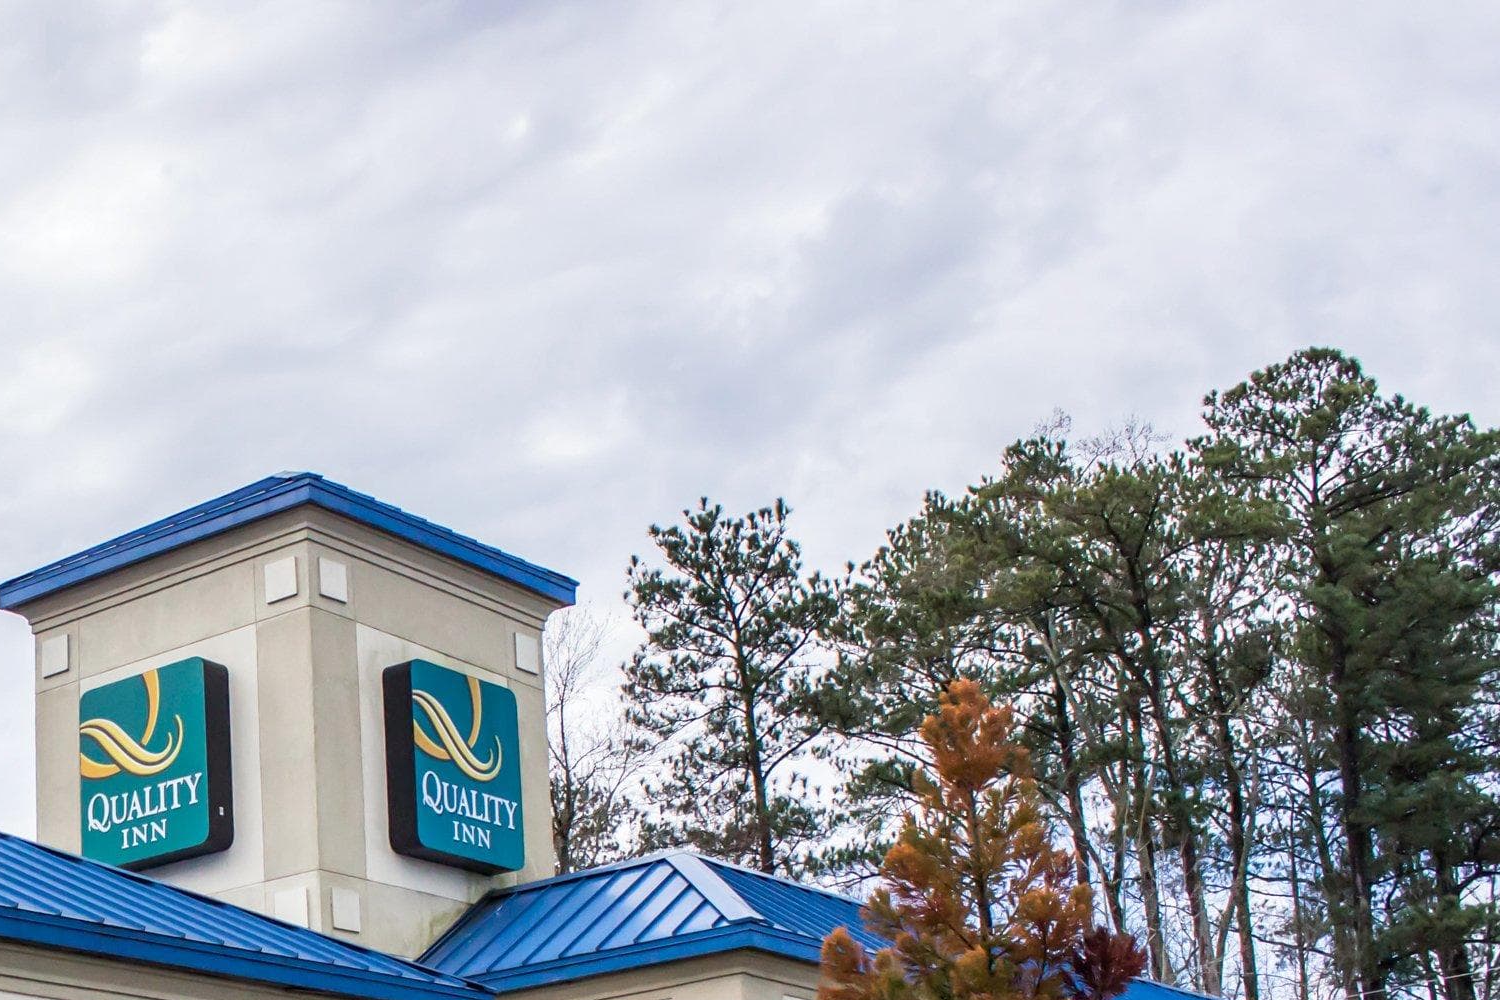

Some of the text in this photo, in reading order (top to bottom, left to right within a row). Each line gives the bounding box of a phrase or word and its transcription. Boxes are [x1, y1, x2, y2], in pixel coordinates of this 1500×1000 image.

[87, 772, 202, 833] QUALITY
[422, 770, 518, 830] QUALITY
[121, 818, 167, 849] INN
[452, 820, 491, 849] INN
